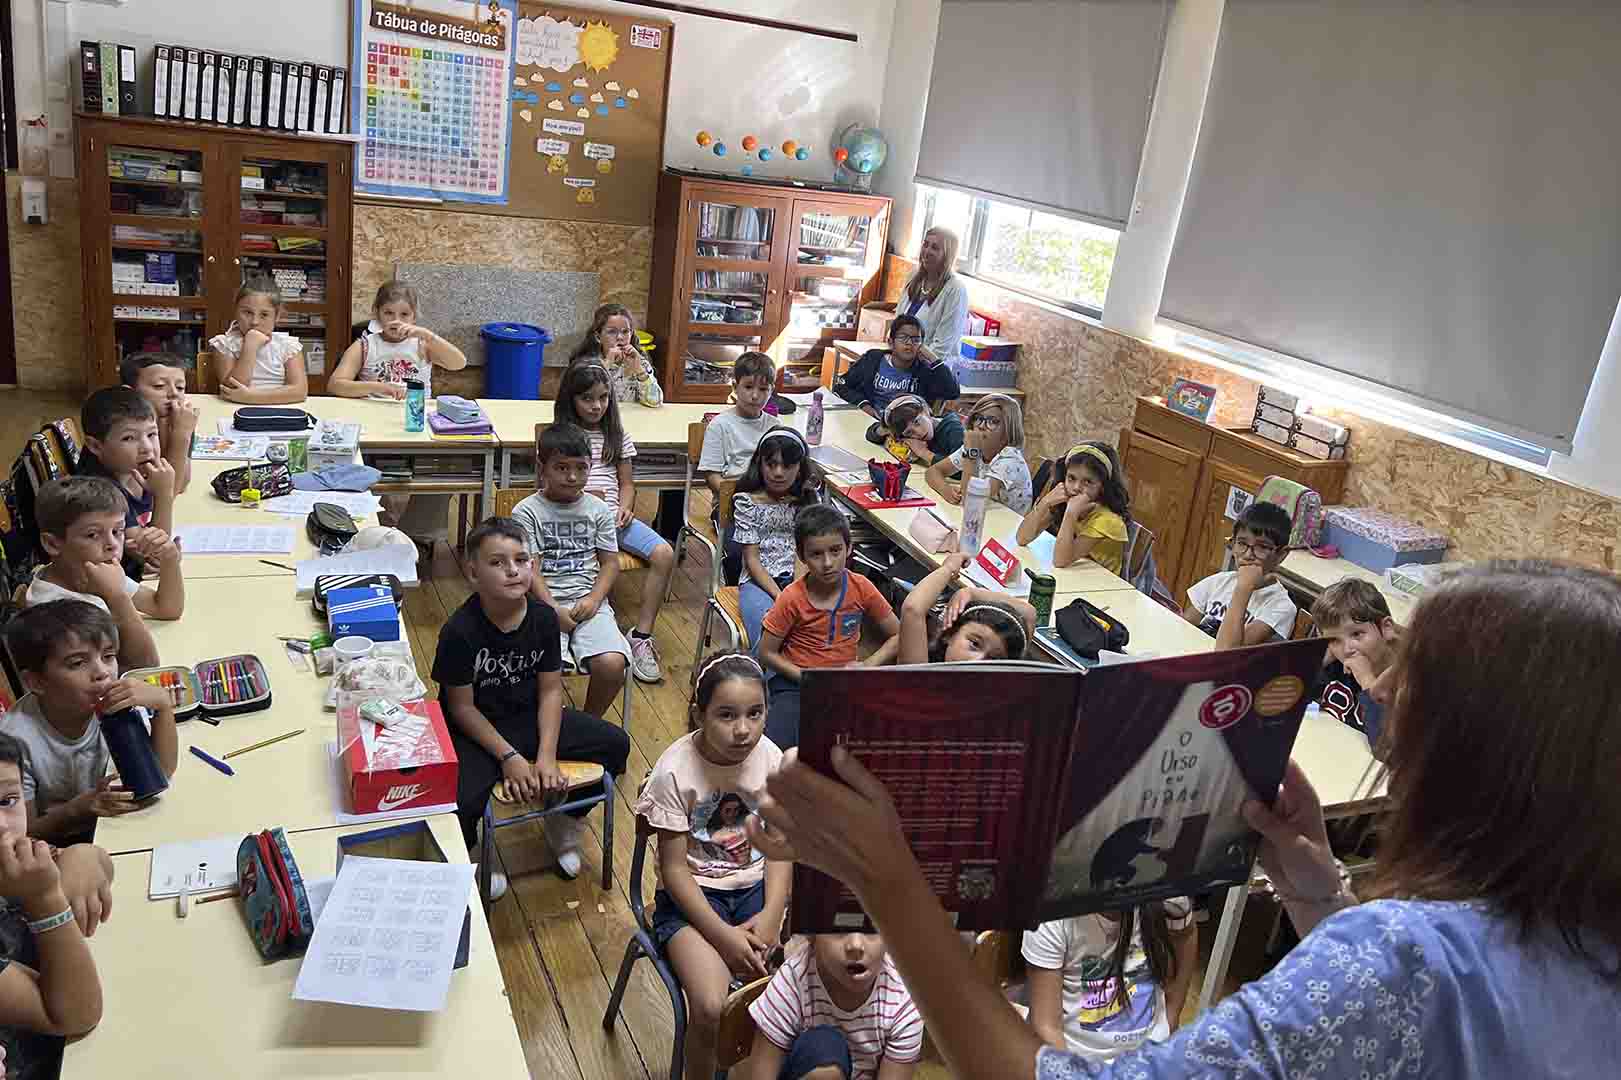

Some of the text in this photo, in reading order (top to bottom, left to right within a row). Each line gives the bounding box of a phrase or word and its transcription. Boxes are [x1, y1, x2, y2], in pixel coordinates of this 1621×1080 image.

[376, 11, 417, 32] Tábua
[420, 20, 437, 35] de
[439, 23, 499, 46] Pitágoras
[1180, 731, 1192, 747] O
[1161, 749, 1198, 775] Urso
[386, 783, 421, 800] NIKE
